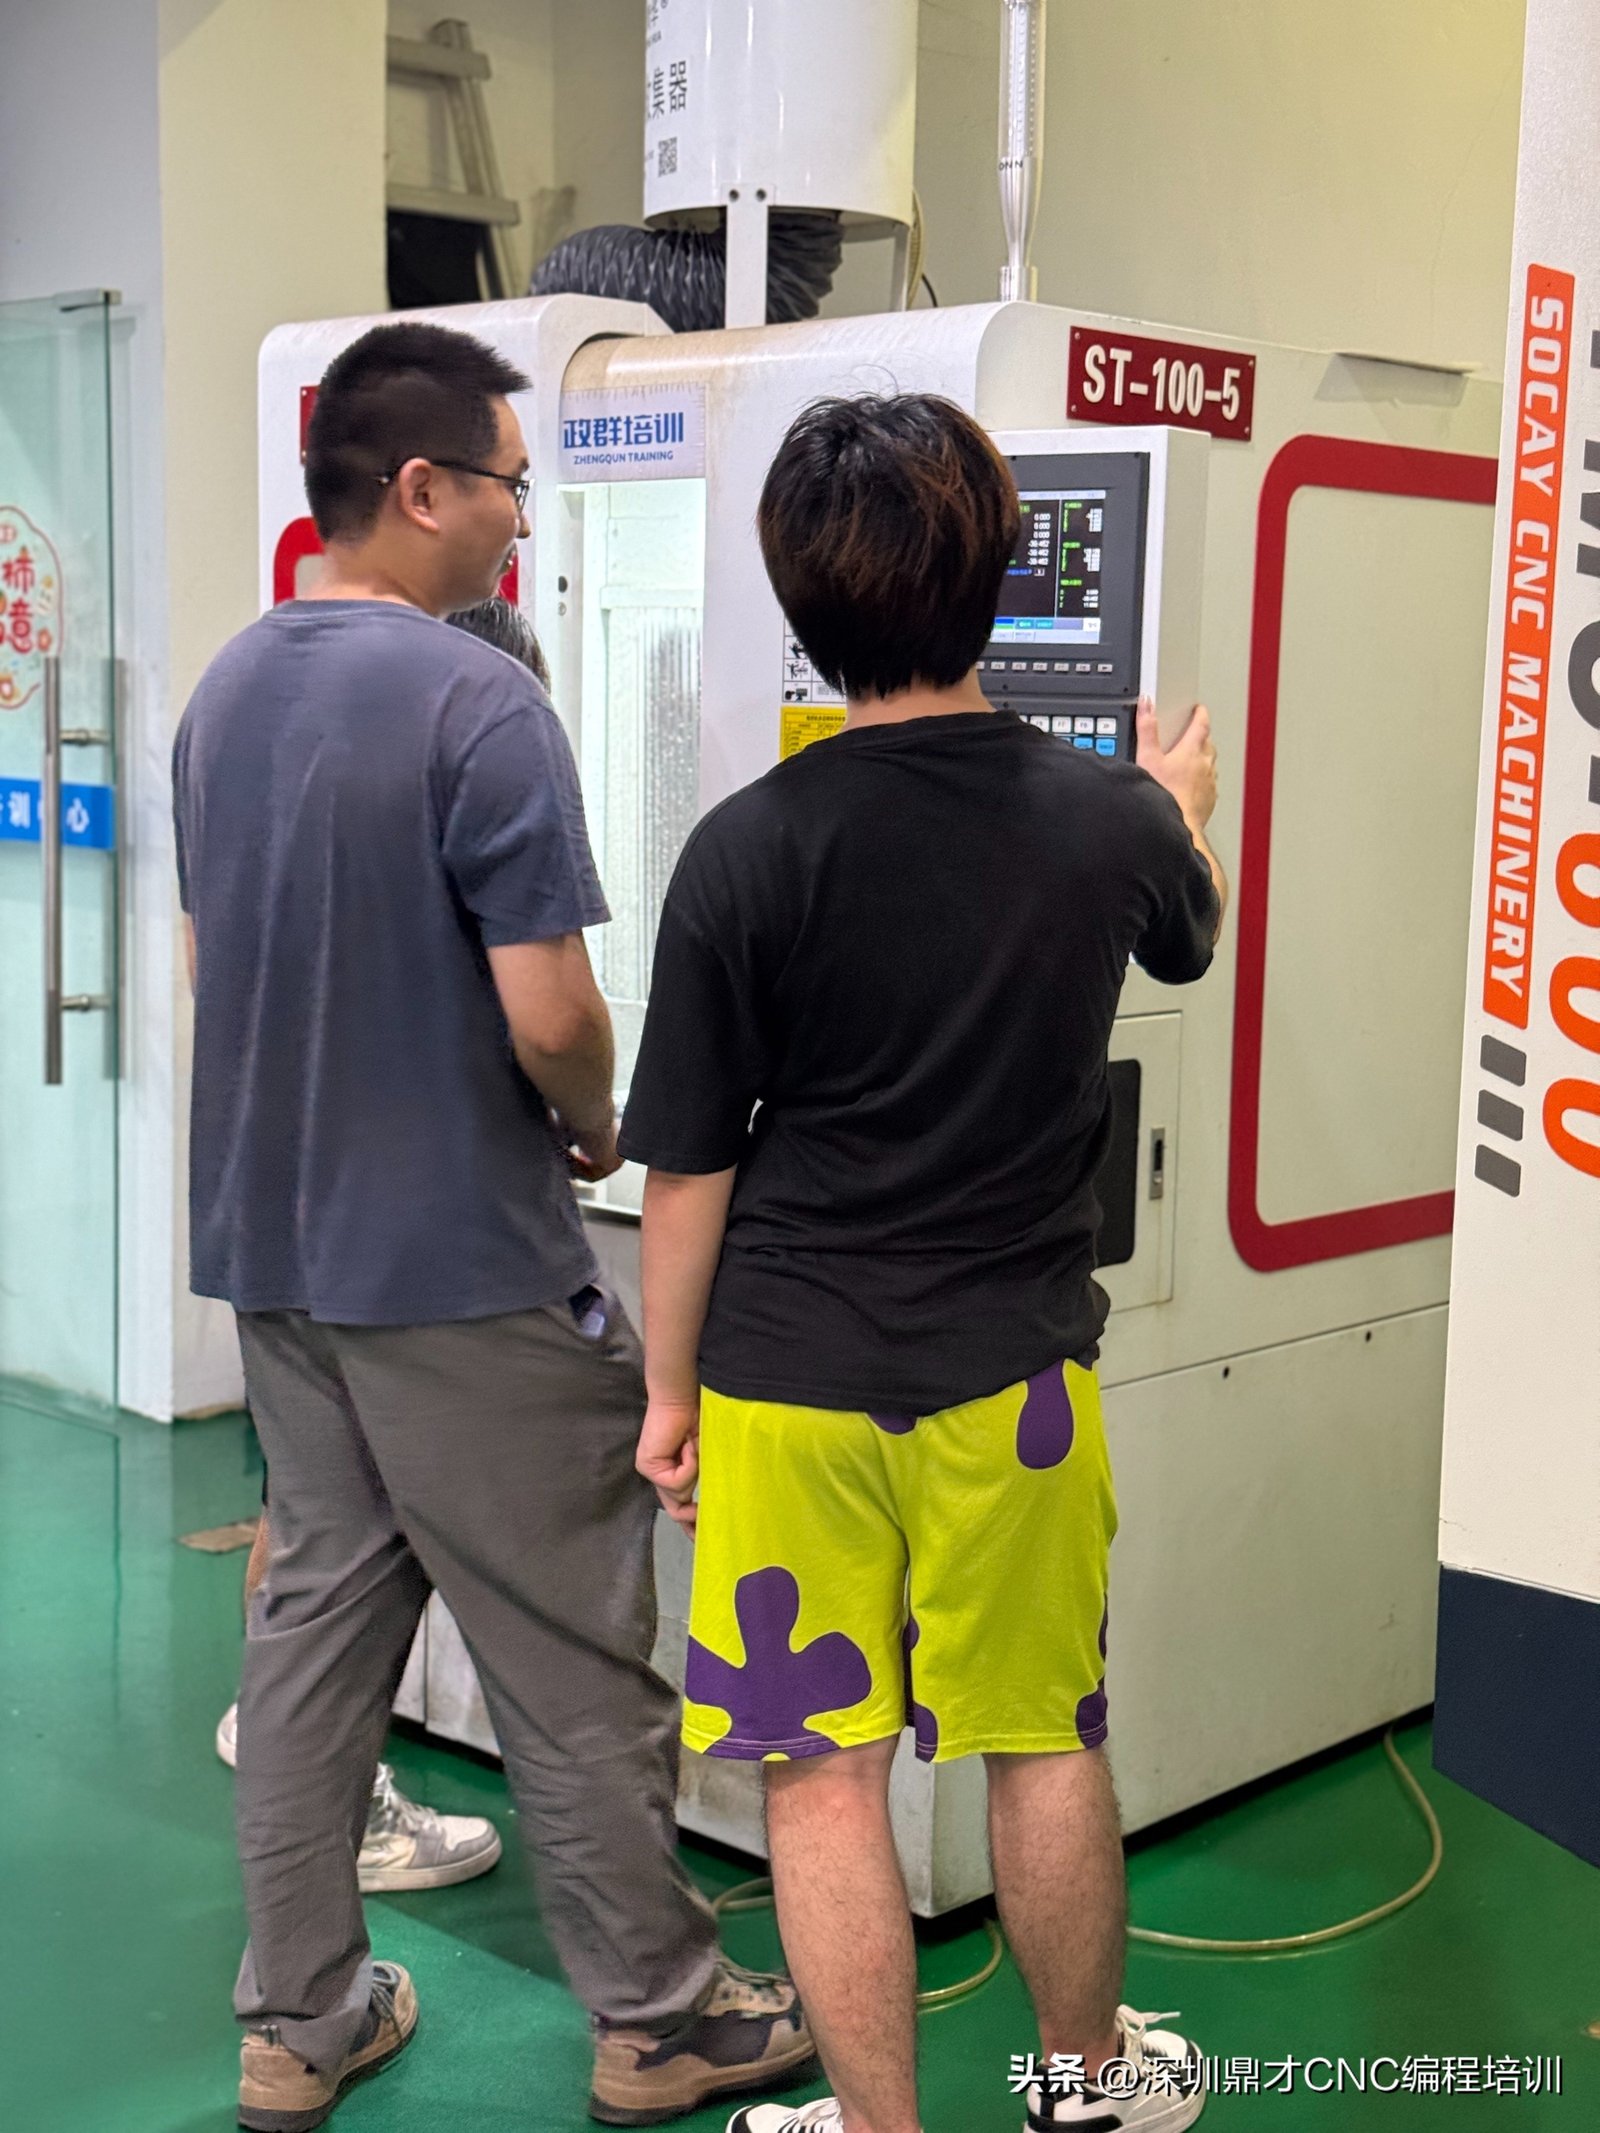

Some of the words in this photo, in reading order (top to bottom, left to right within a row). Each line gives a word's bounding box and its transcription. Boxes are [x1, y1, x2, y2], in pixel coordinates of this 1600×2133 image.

[563, 411, 685, 449] 政群培训
[1082, 344, 1241, 421] ST-100-5
[1519, 295, 1565, 497] SOCAY
[573, 452, 626, 465] ZHENGQUN
[628, 450, 674, 463] TRAINING
[1510, 518, 1551, 632] CNC
[1490, 650, 1544, 999] MACHINERY
